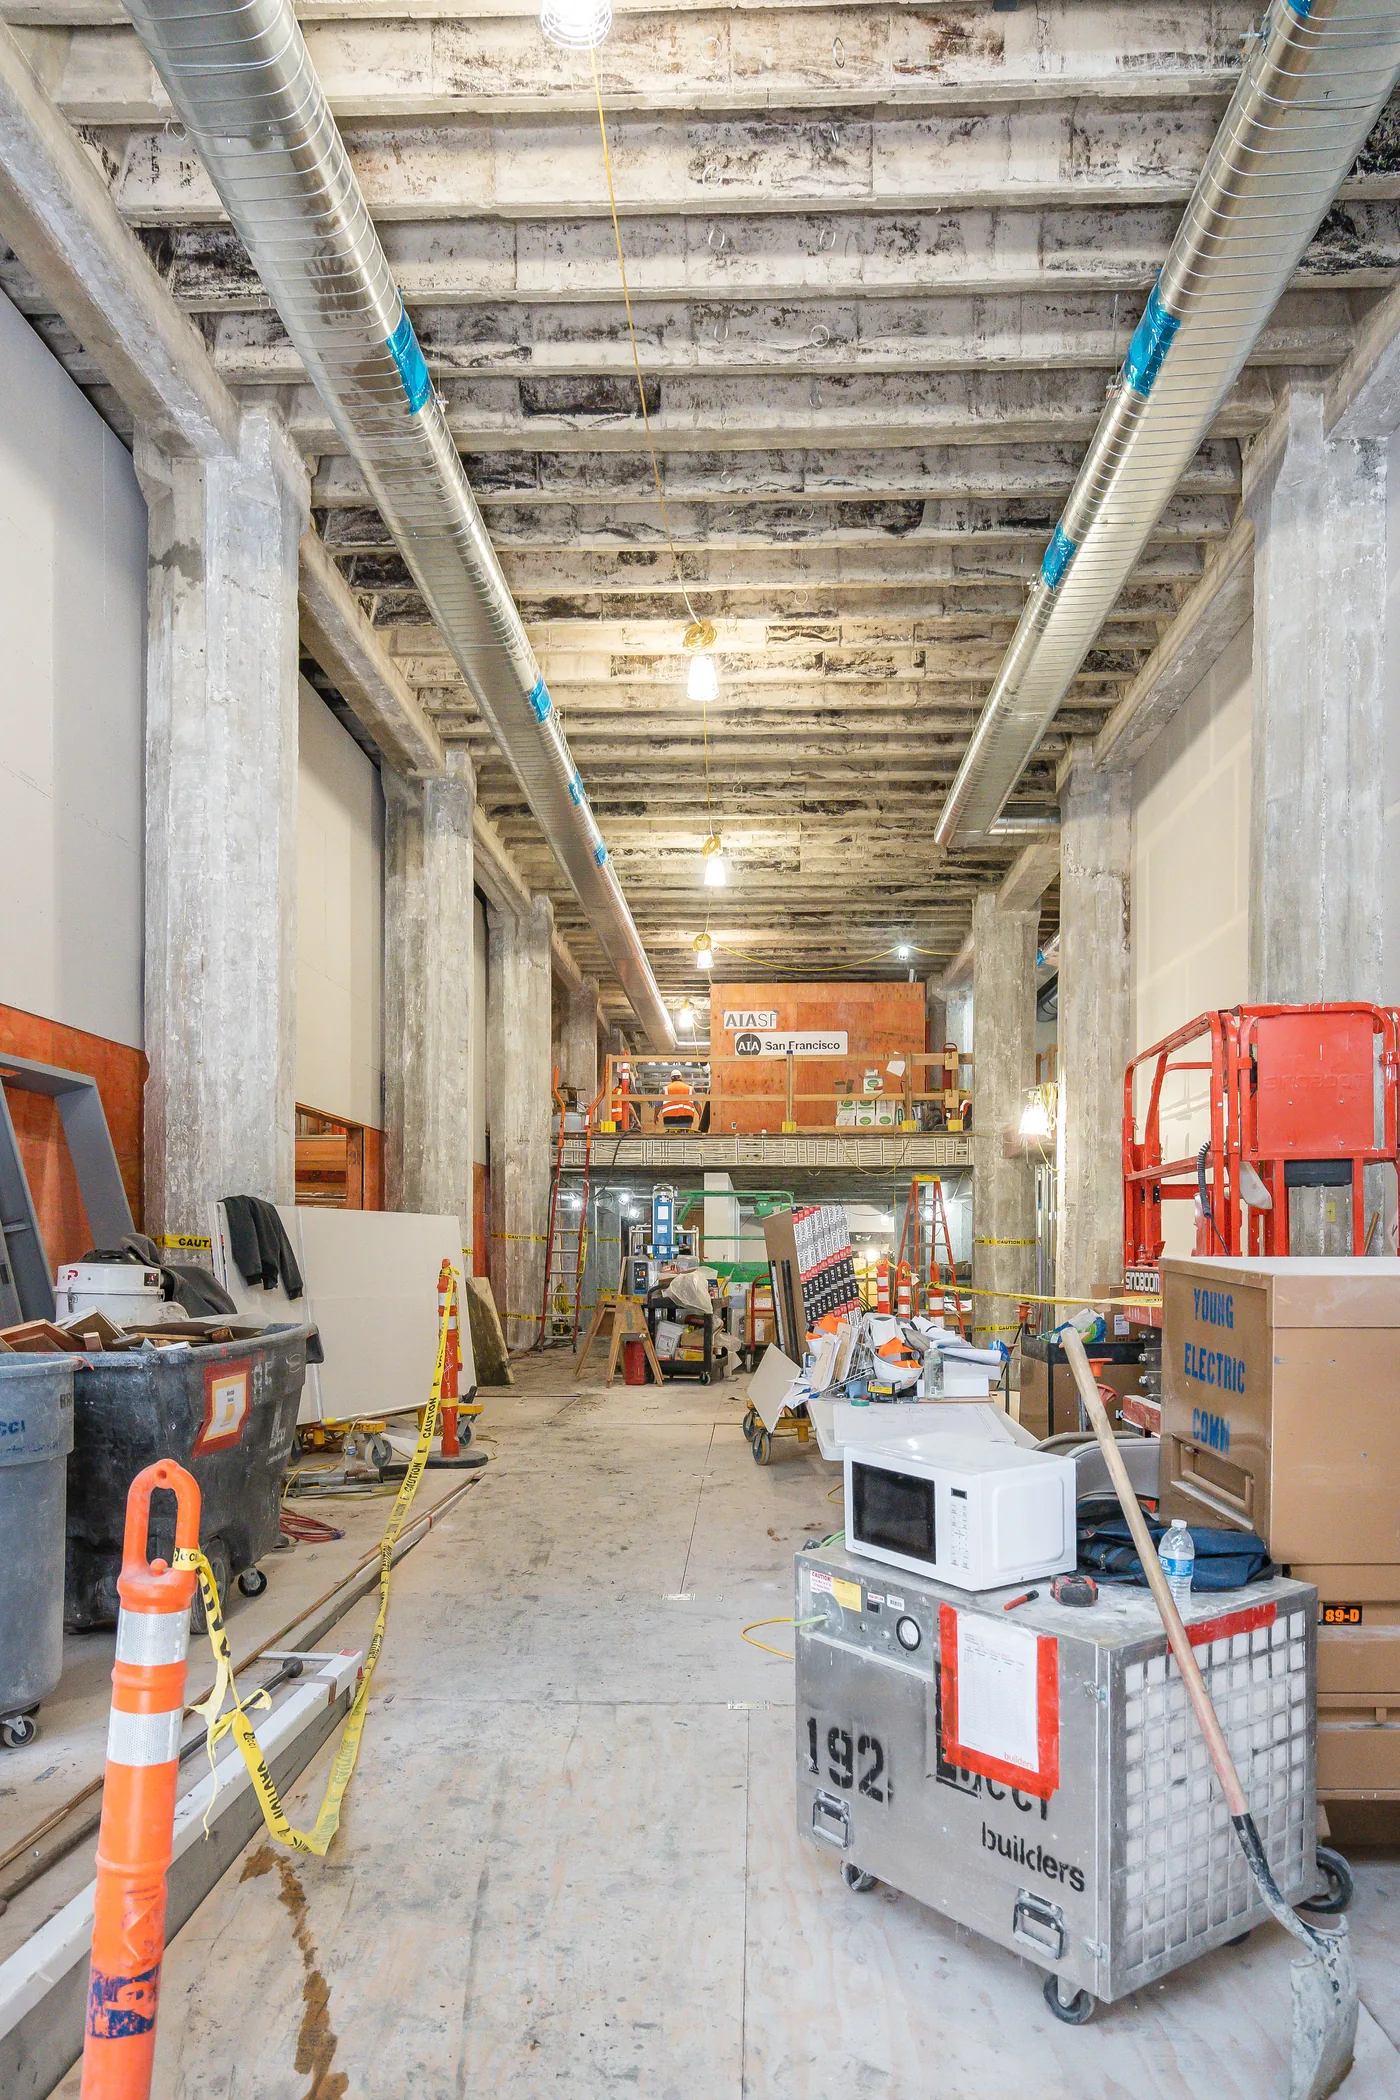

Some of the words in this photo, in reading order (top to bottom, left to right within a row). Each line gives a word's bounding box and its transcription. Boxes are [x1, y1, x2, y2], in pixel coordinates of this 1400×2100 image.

[738, 1041, 759, 1052] AIA
[765, 1041, 785, 1050] San
[788, 1040, 840, 1050] Francisco
[1193, 1288, 1234, 1329] YOUNG
[1184, 1342, 1245, 1395] ELECTRIC
[422, 1397, 437, 1439] CAUTION
[404, 1462, 422, 1493] CAUTION
[1325, 1609, 1360, 1623] 89-D
[807, 1717, 884, 1804] 192
[1004, 1752, 1034, 1770] builders
[981, 1821, 1086, 1892] builders
